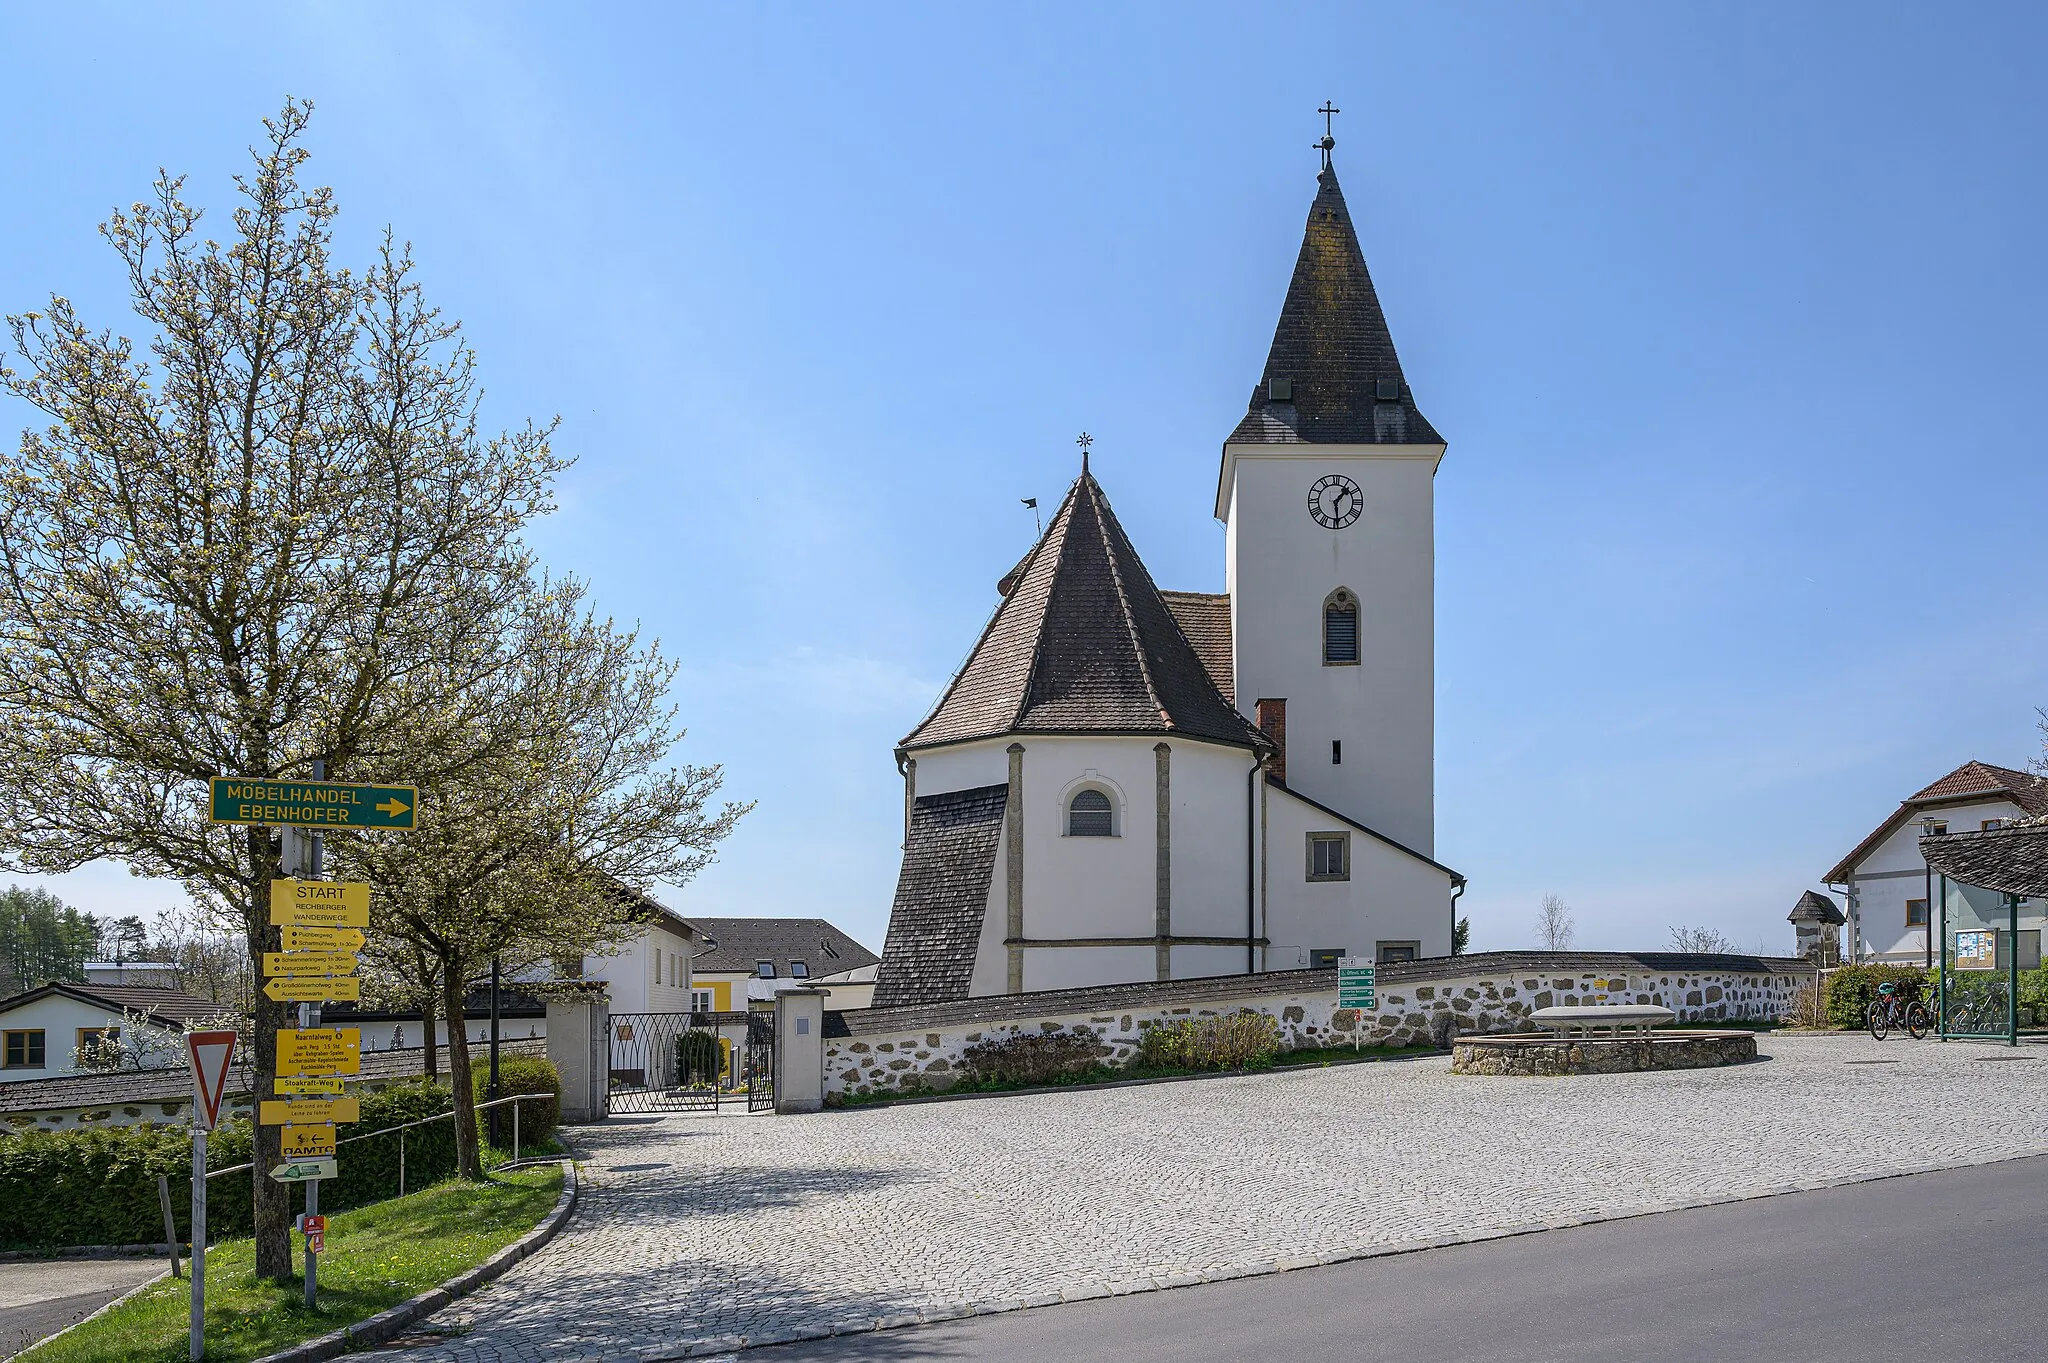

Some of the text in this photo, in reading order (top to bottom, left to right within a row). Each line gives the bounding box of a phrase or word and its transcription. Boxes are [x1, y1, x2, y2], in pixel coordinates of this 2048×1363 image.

[227, 783, 361, 805] MÖBELHANDEL
[239, 804, 349, 823] EBENHOFER
[296, 886, 346, 899] START
[295, 903, 347, 911] RECHBERGER
